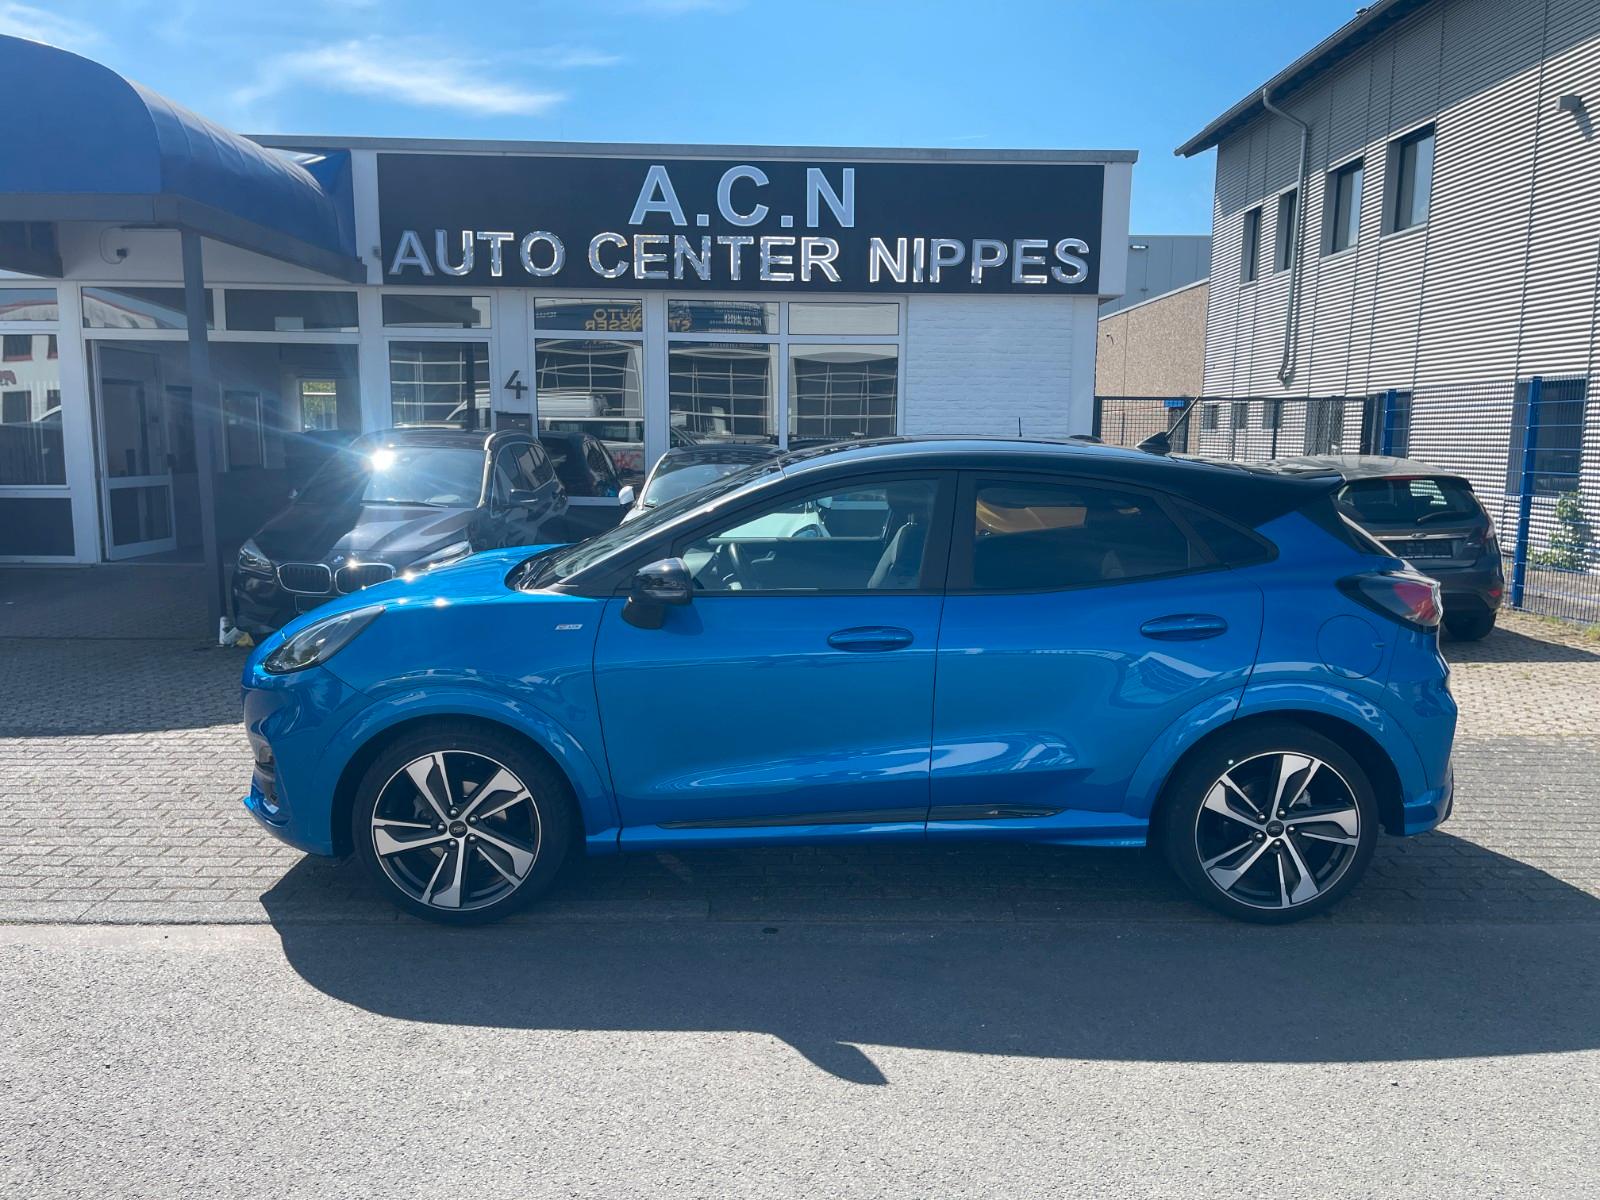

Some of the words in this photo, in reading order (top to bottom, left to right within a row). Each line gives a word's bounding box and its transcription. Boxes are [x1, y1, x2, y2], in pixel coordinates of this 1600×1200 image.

[629, 164, 855, 228] A.C.N
[388, 230, 566, 277] AUTO
[588, 231, 842, 282] CENTER
[869, 237, 1090, 284] NIPPES
[503, 370, 528, 400] 4
